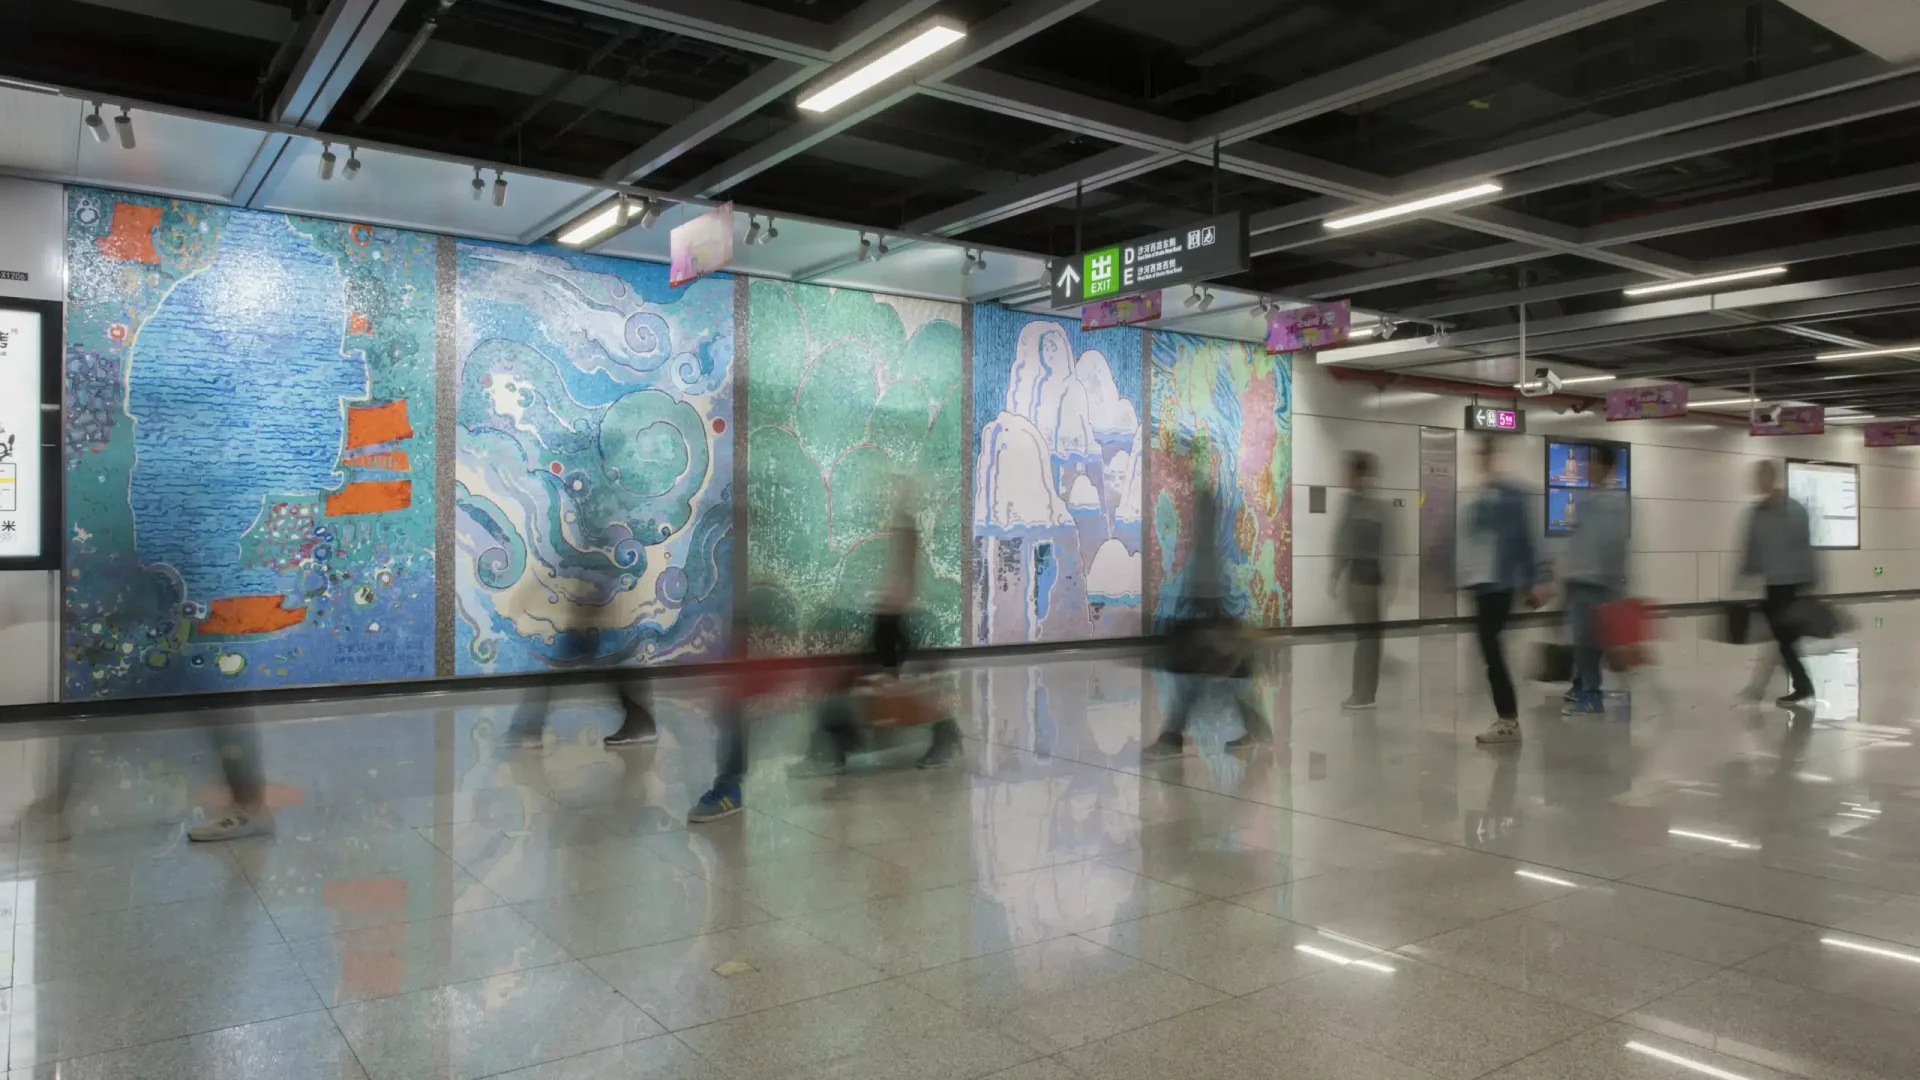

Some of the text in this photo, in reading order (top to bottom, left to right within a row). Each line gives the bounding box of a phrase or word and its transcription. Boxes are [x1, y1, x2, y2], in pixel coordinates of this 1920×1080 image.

[1138, 237, 1176, 255] 沙河西路东侧
[1125, 247, 1135, 265] D
[1092, 255, 1111, 281] 出
[1137, 258, 1176, 275] 沙河西路西侧
[1124, 267, 1134, 285] E
[1092, 278, 1111, 293] EXIT
[2, 520, 16, 533] 米
